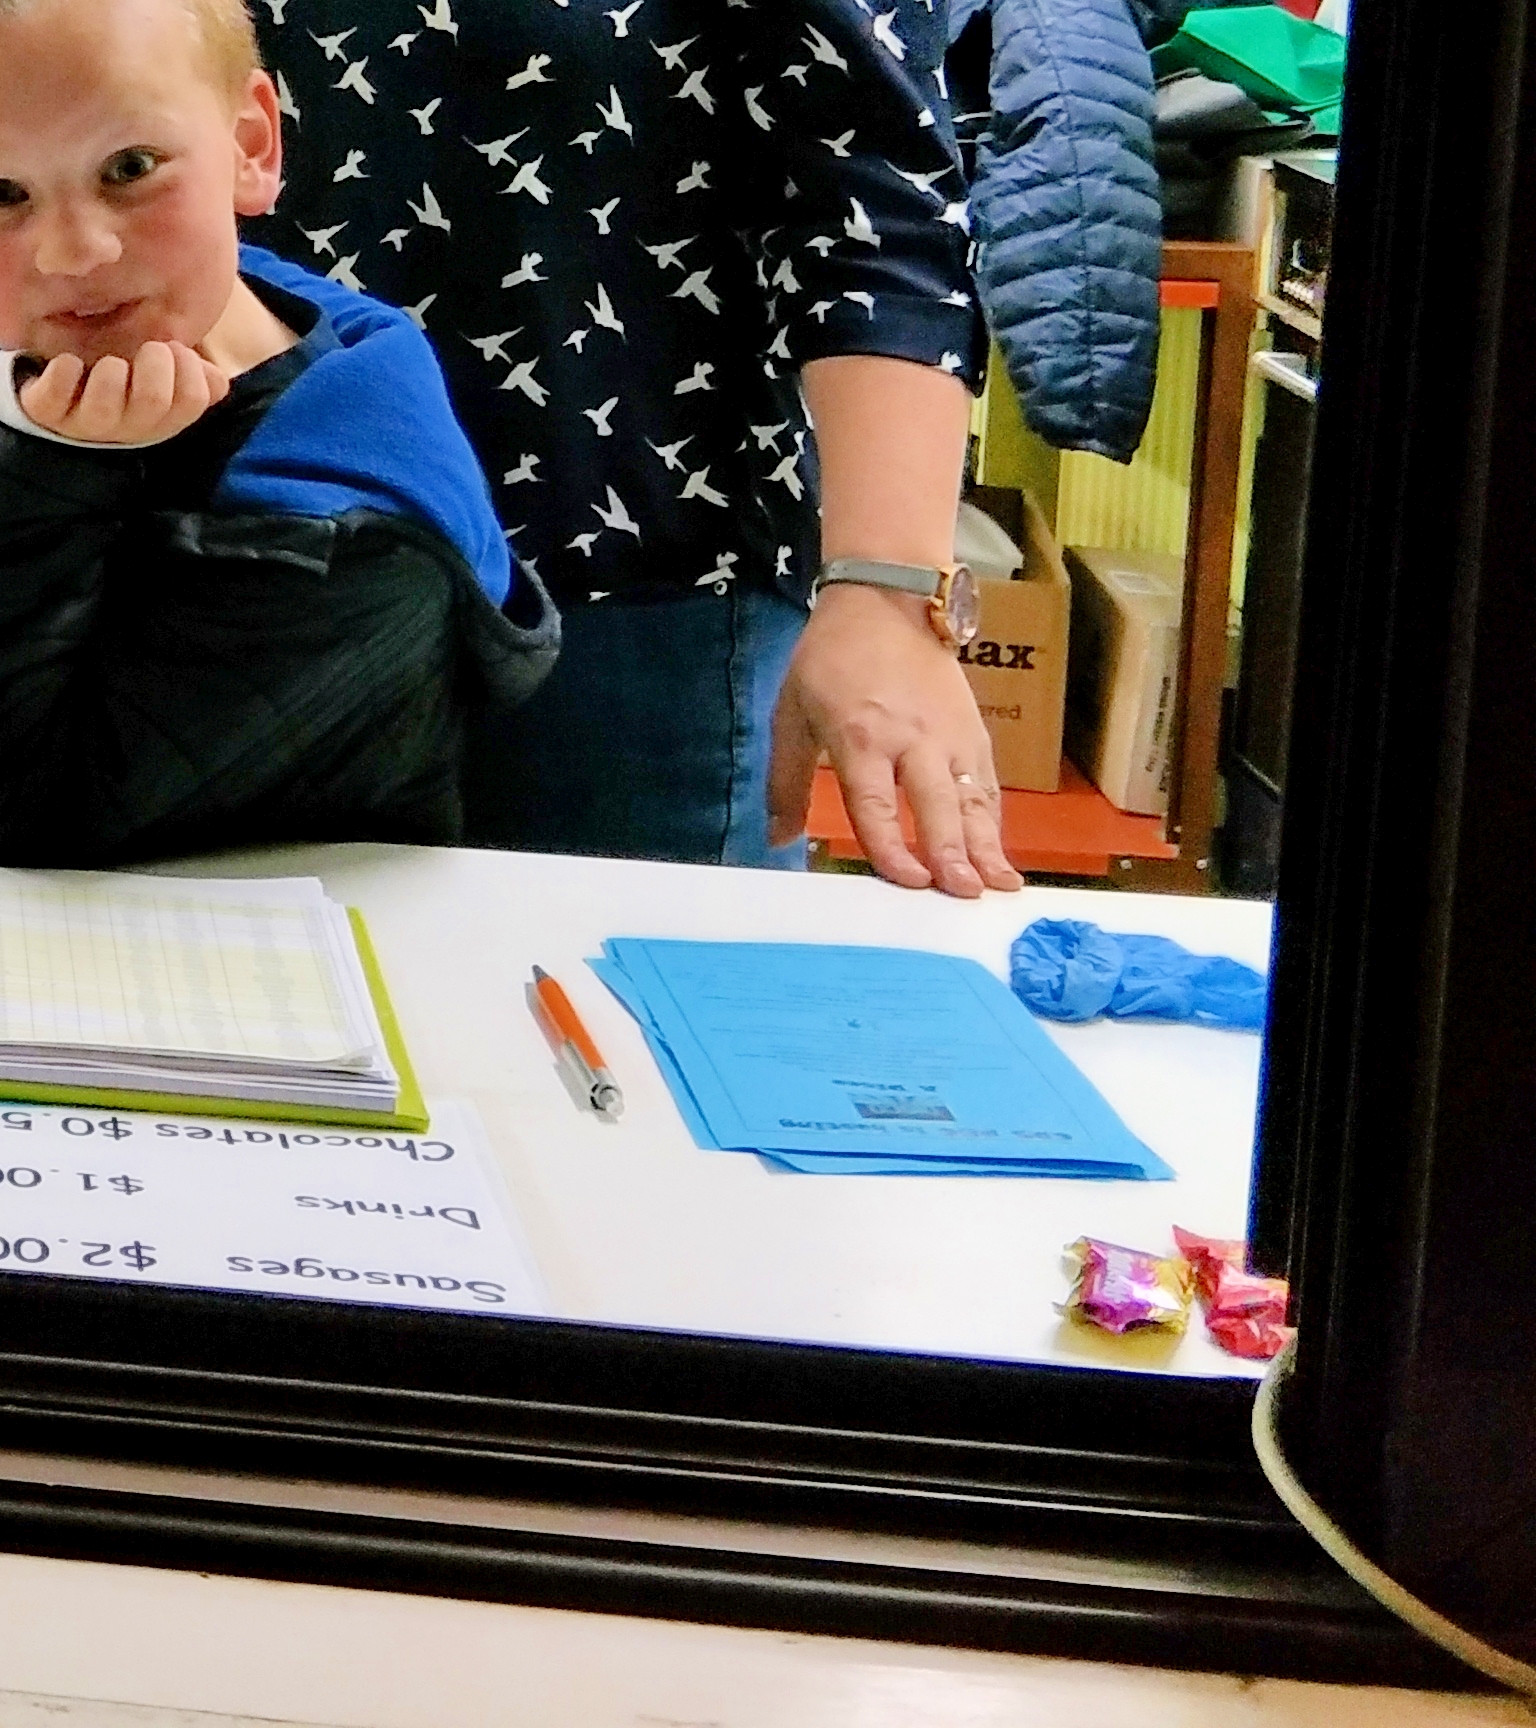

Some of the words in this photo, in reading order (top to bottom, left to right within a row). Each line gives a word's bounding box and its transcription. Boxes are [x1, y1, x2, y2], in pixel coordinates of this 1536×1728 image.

[154, 1122, 456, 1162] Chocolates
[294, 1194, 482, 1230] Drinks
[225, 1255, 508, 1304] Sausages
